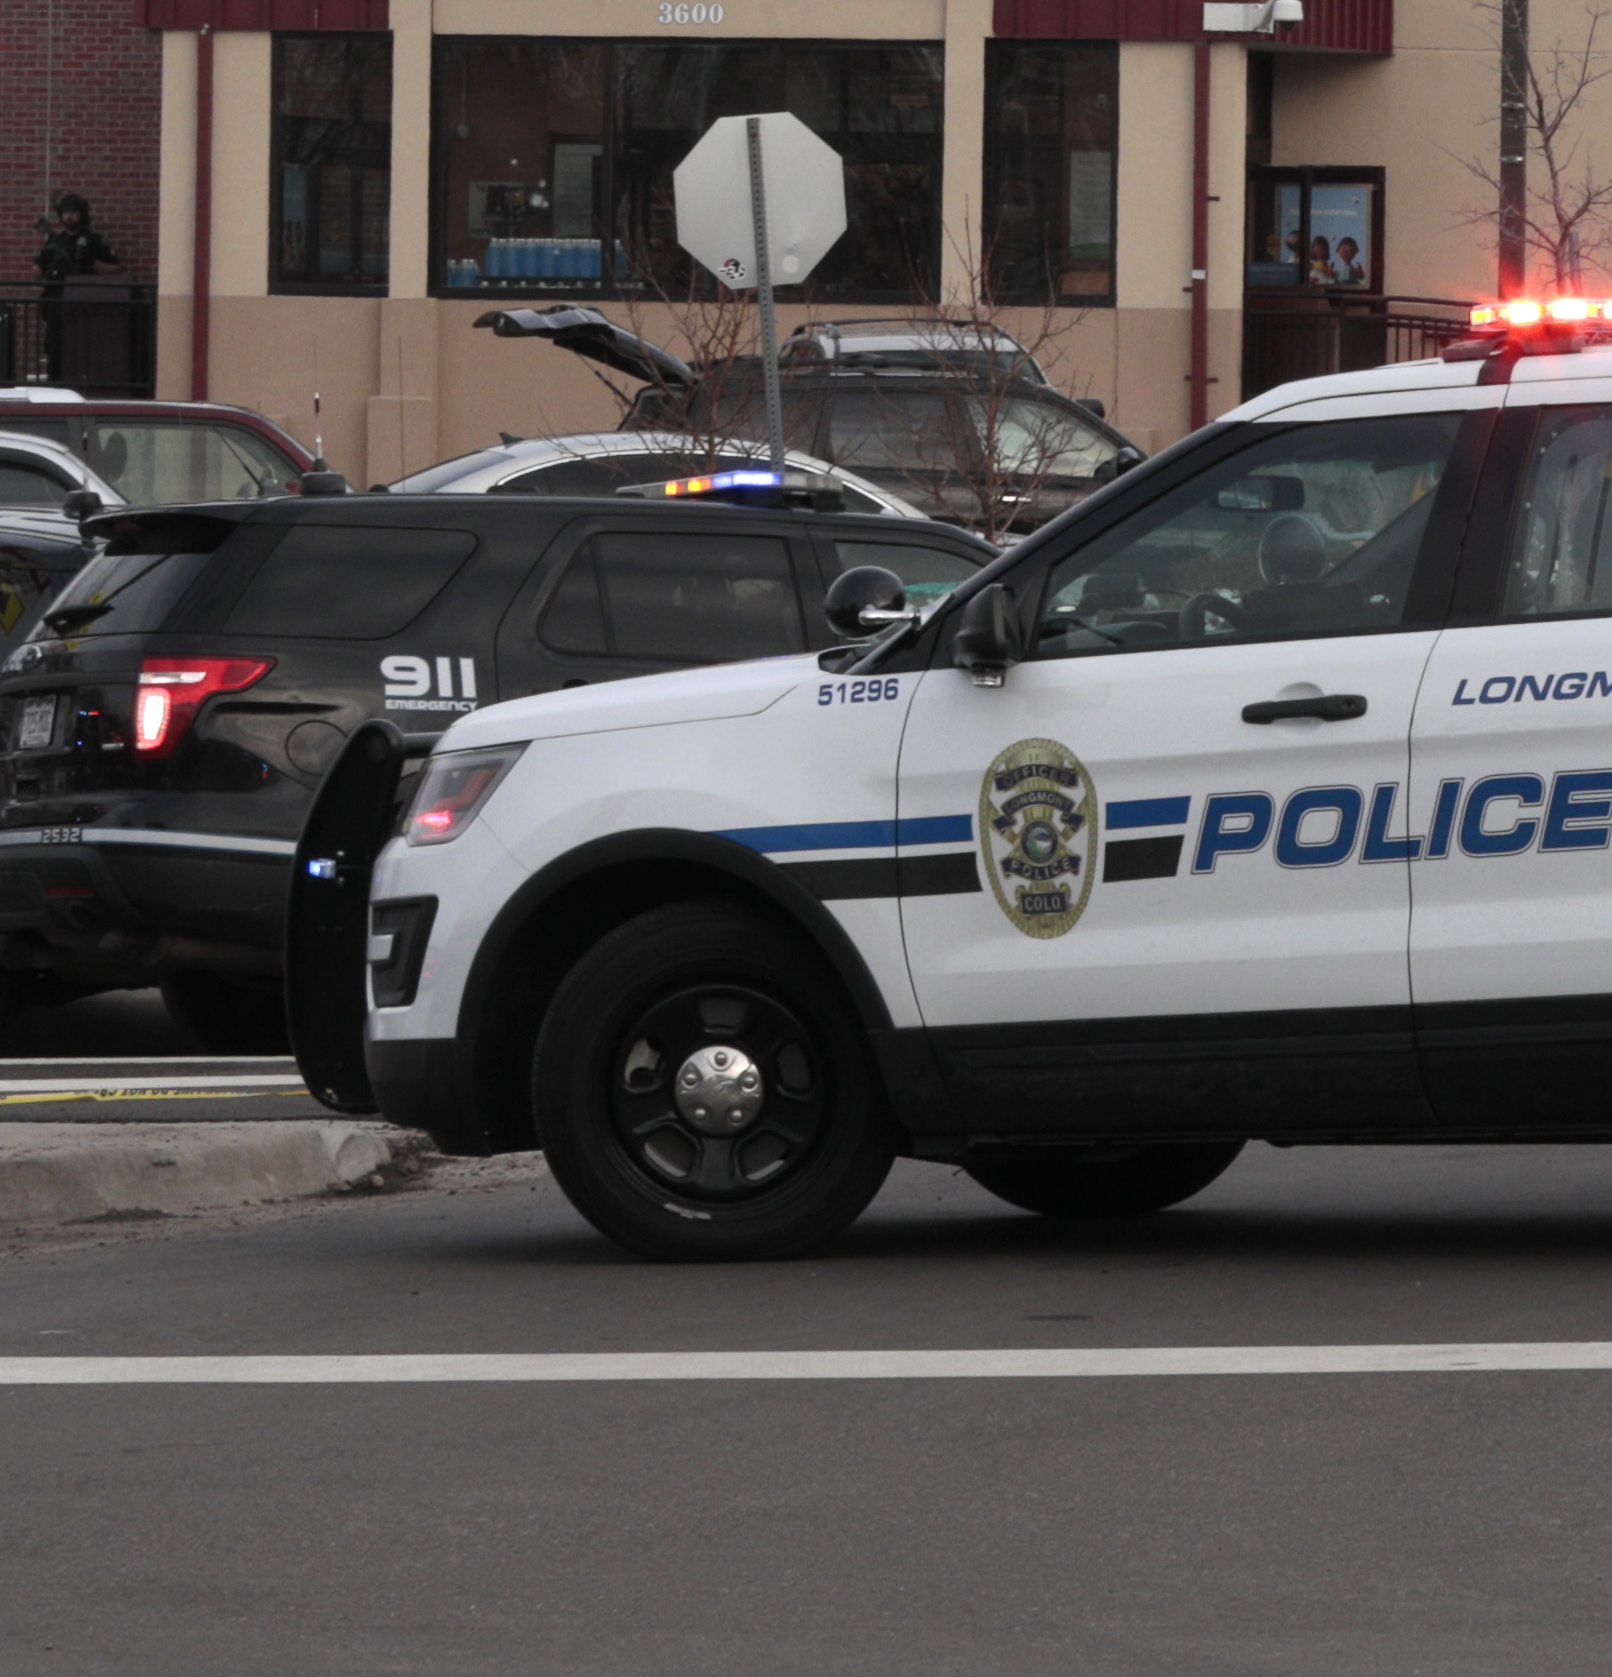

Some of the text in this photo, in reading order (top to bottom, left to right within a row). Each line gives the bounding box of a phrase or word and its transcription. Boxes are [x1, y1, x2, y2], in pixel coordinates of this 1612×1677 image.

[658, 2, 725, 25] 3600
[380, 655, 477, 699] 911
[817, 678, 900, 707] 51296
[385, 698, 478, 712] EMERGENCY
[1002, 765, 1071, 787] OFFICER
[1004, 791, 1072, 814] LONGMONT
[42, 827, 81, 843] 2532
[1011, 858, 1072, 880] POLICE
